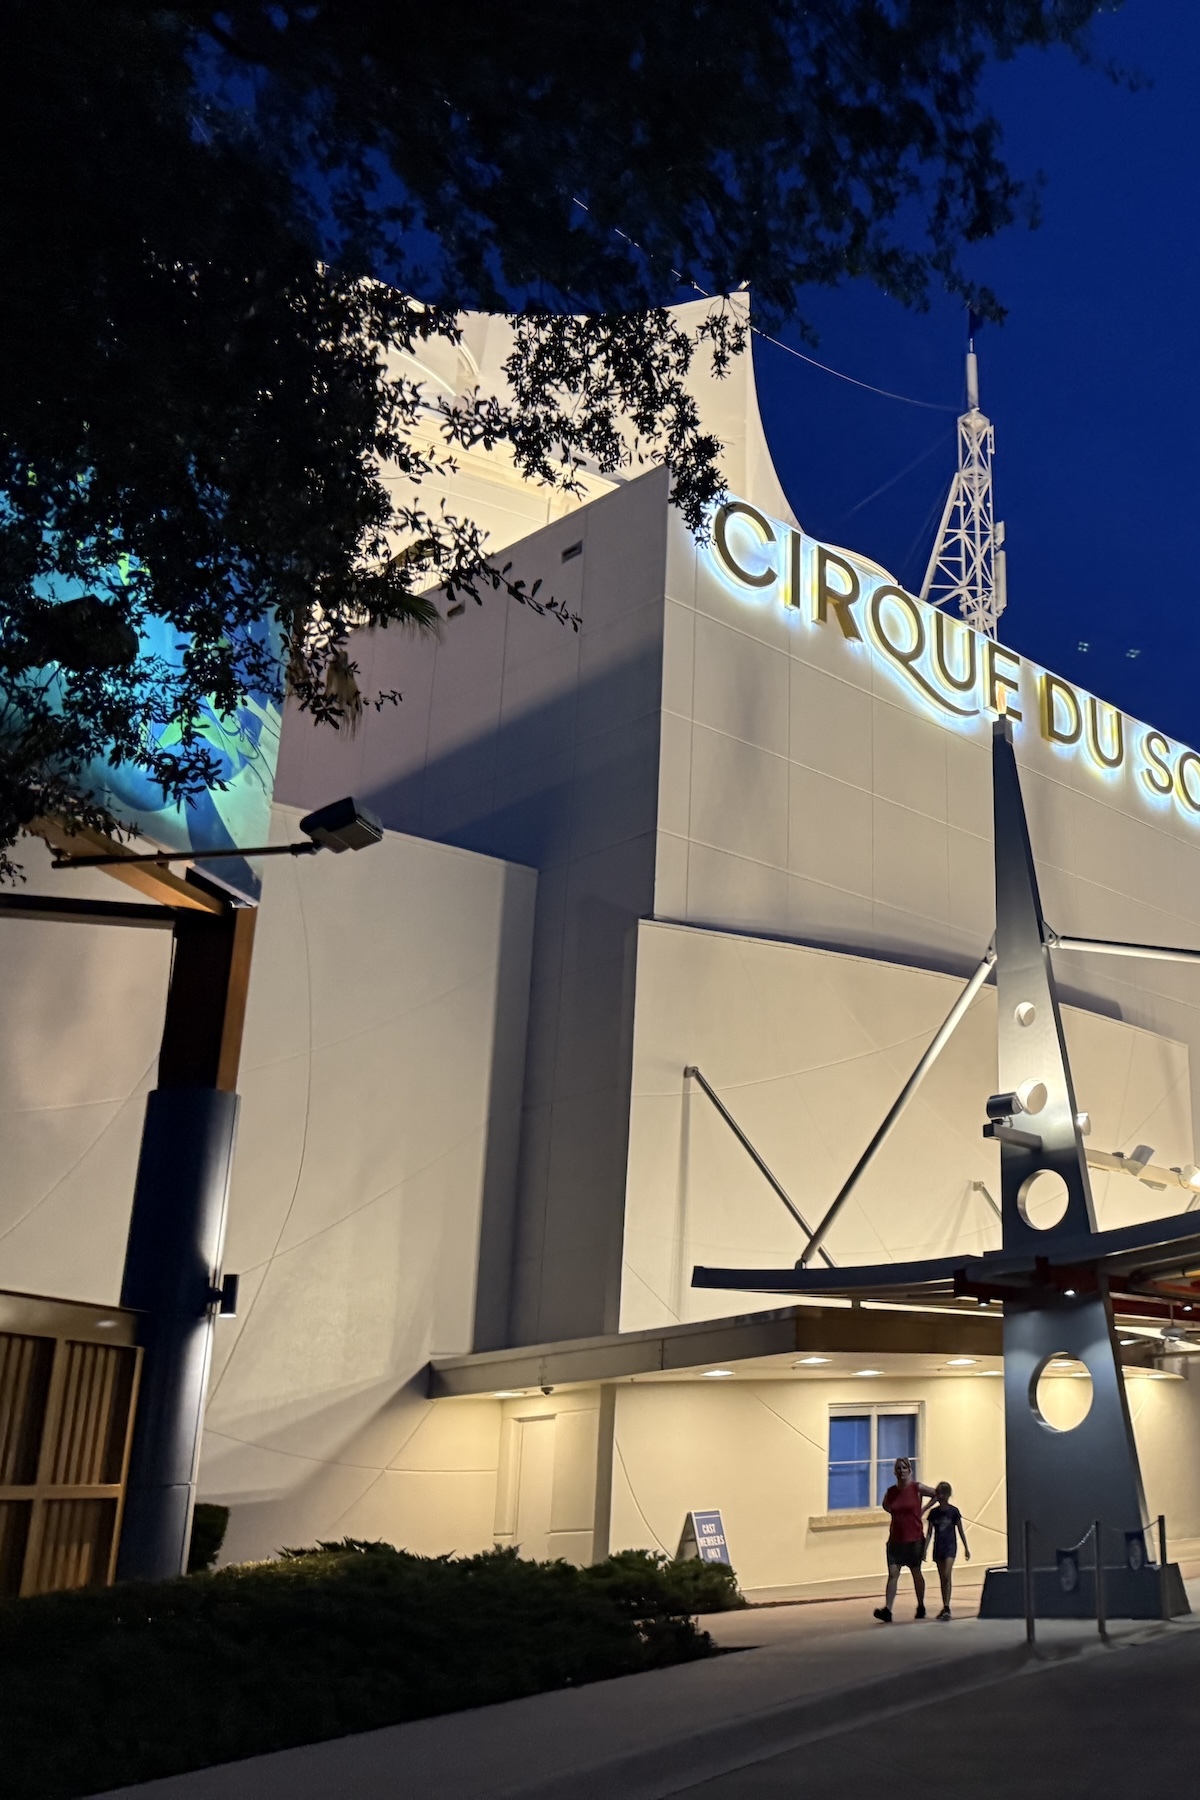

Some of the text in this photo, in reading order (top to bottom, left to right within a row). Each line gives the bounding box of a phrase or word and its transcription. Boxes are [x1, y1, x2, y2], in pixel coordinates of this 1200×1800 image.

[711, 500, 1023, 722] CIRQUE
[1039, 672, 1124, 768] DU
[701, 1523, 716, 1535] CAST
[699, 1535, 725, 1547] MEMBERS
[706, 1548, 721, 1559] ONLY
